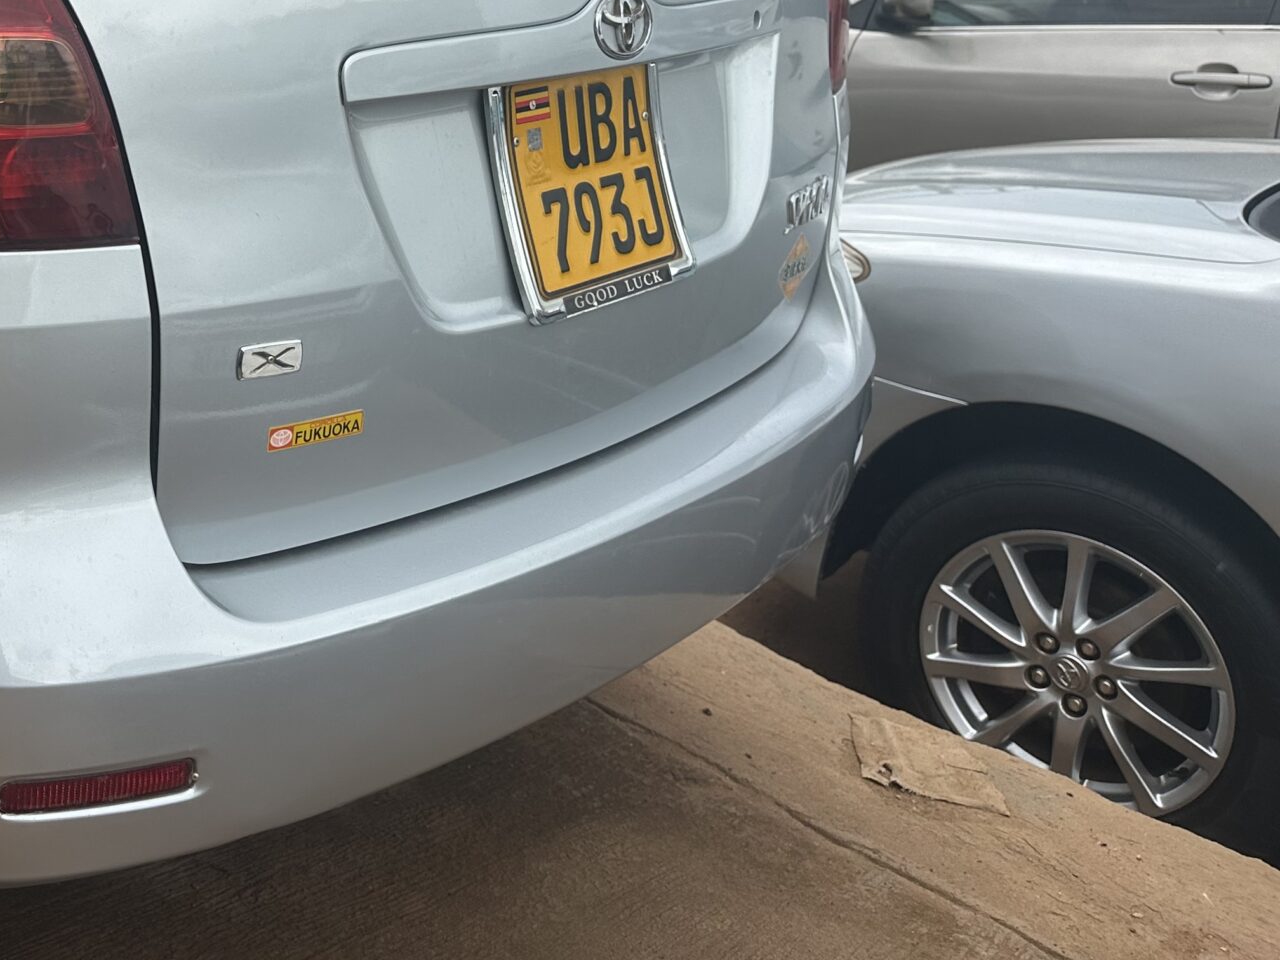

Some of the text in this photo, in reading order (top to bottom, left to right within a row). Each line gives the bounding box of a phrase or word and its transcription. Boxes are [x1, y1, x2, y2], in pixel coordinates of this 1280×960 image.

[557, 76, 646, 170] UBA
[540, 165, 665, 274] 793J
[574, 269, 663, 309] GOOD LUCK
[294, 419, 360, 445] FUKUOKA
